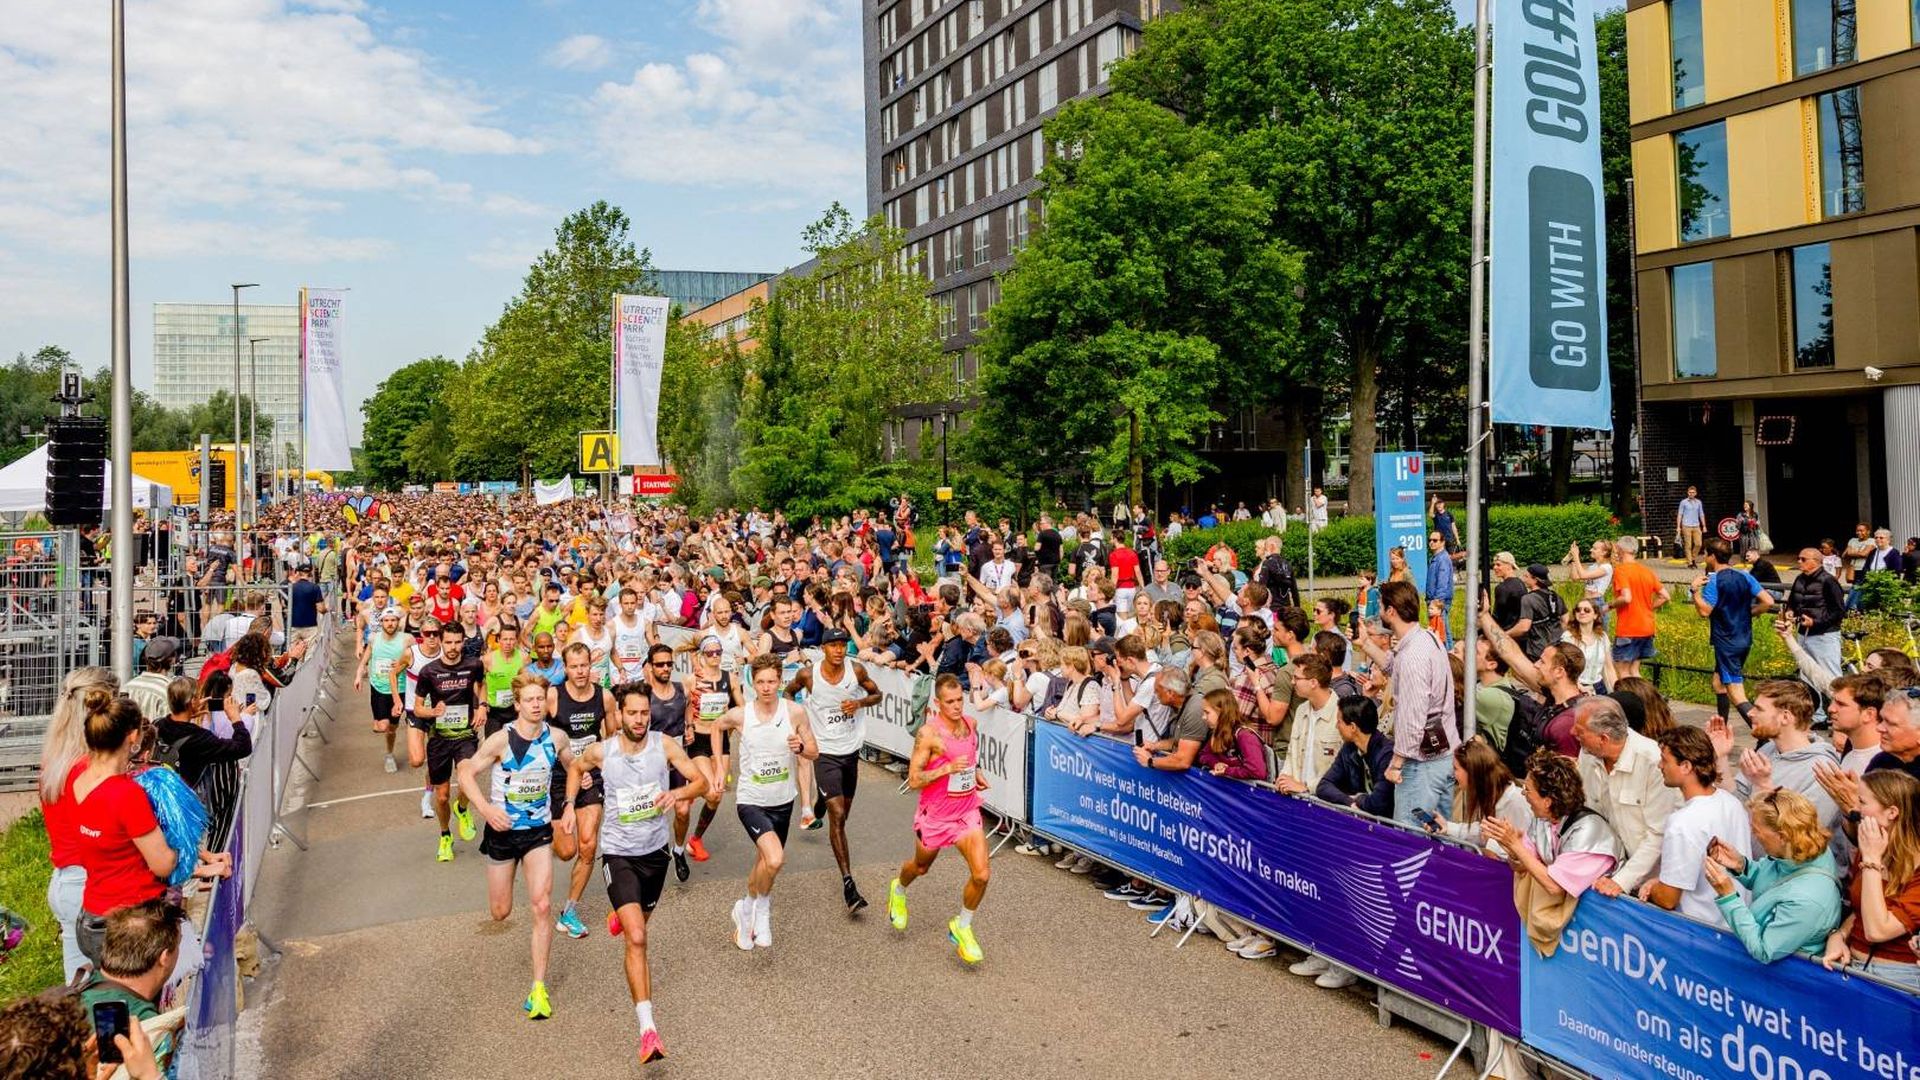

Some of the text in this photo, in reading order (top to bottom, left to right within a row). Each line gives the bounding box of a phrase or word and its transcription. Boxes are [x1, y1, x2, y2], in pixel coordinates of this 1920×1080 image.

[1522, 0, 1588, 143] GOLA
[309, 299, 342, 309] UTRECHT
[1549, 221, 1587, 368] GO WITH
[623, 304, 664, 315] UTRECHT
[311, 318, 329, 328] PARK
[623, 324, 645, 333] PARK
[588, 437, 614, 468] A
[634, 477, 641, 493] 1
[1400, 535, 1423, 551] 320
[976, 733, 1009, 780] ARK
[760, 766, 782, 776] 3076
[1049, 745, 1203, 820] GenDx weet wat het betekent
[518, 785, 541, 793] 3064
[629, 800, 654, 813] 3063
[1080, 792, 1322, 901] om als donor het verschil te maken.
[1127, 832, 1151, 854] Utrecht
[1416, 901, 1504, 965] GENDX
[1560, 928, 1668, 991] GenDx
[1673, 974, 1736, 1018] weet
[1741, 1000, 1792, 1040] wat
[1801, 1015, 1849, 1062] het
[1558, 1009, 1611, 1046] Daarom
[1636, 1009, 1833, 1080] om als don
